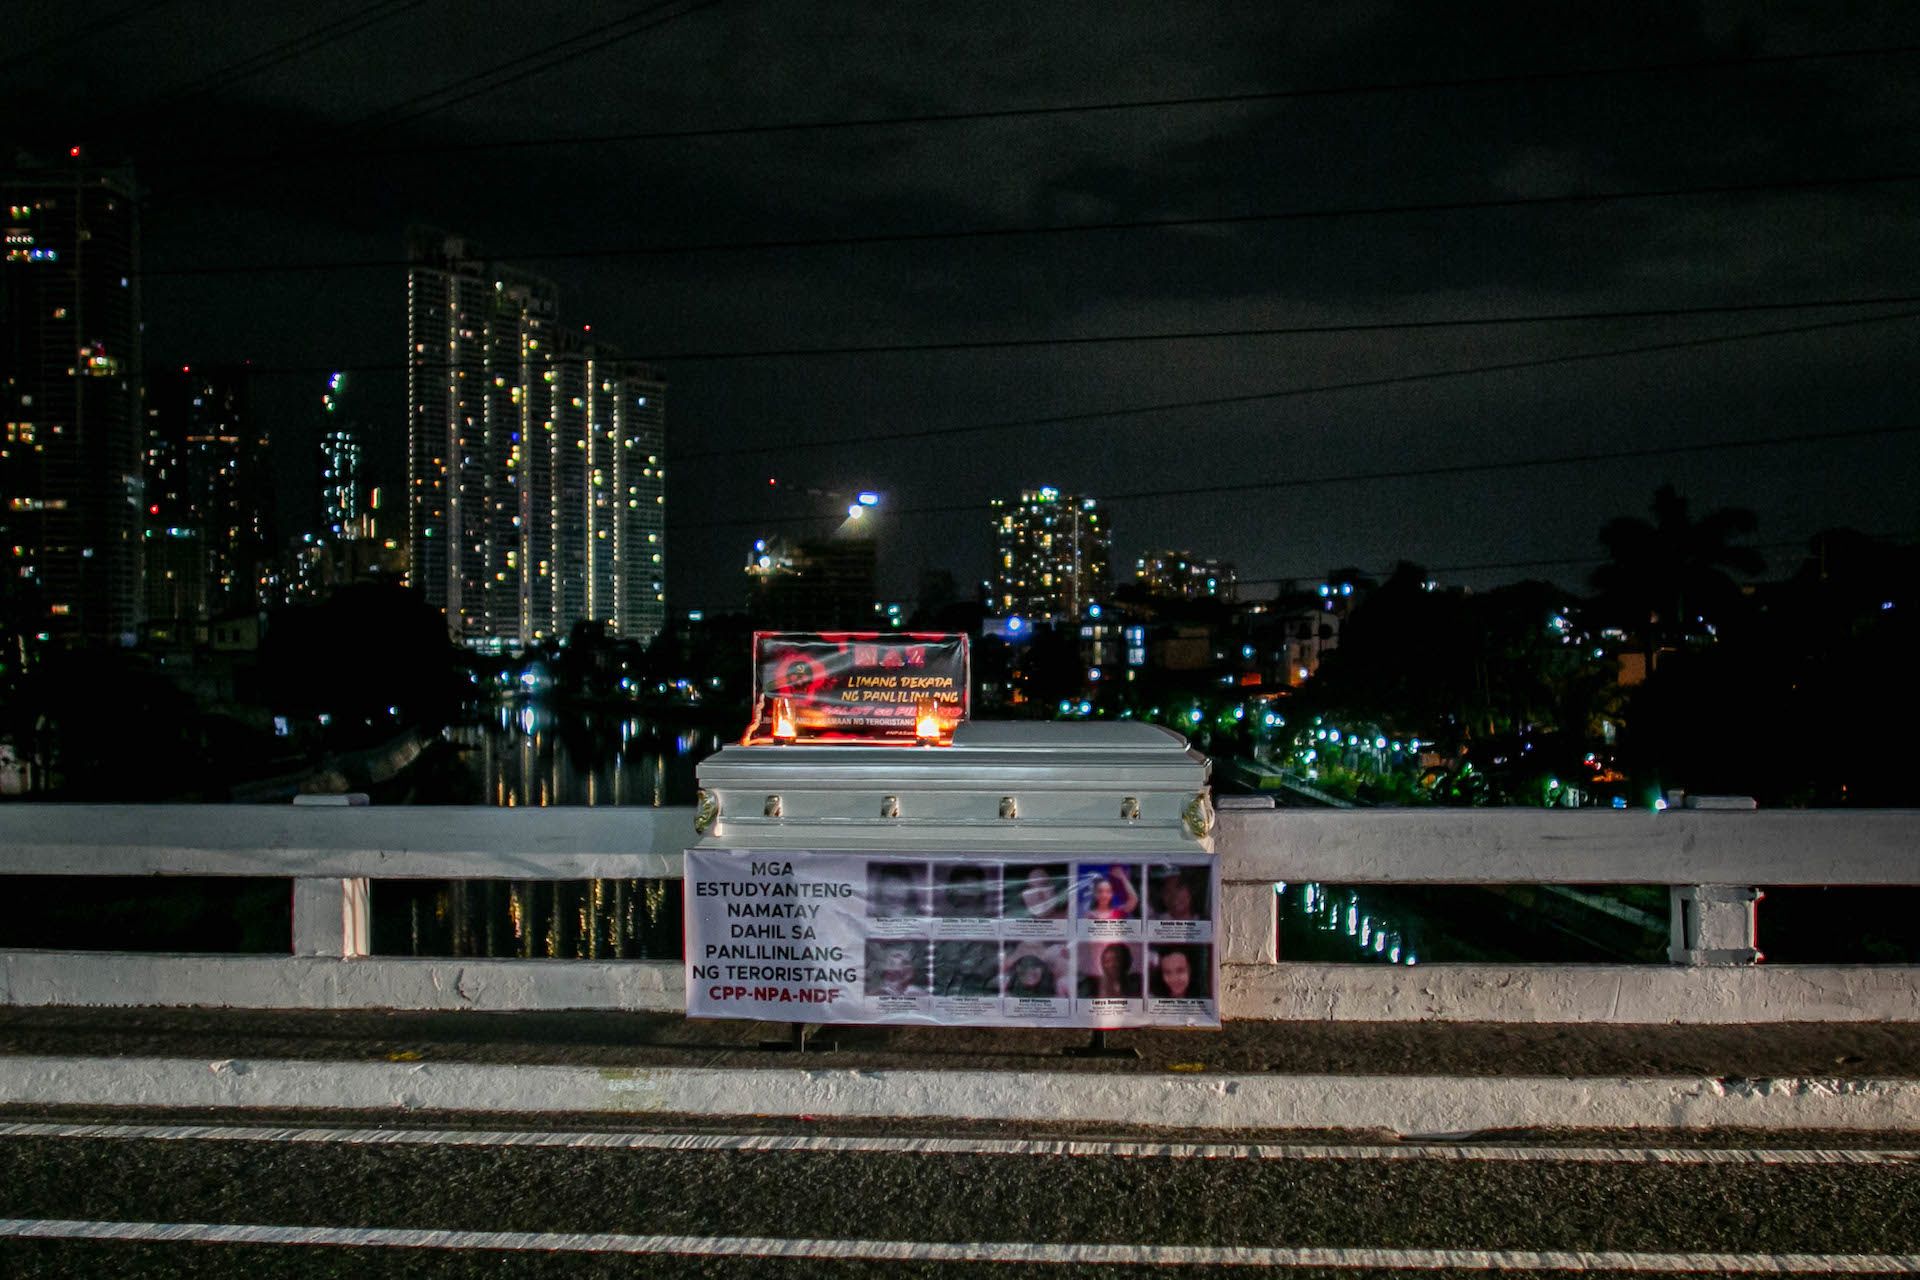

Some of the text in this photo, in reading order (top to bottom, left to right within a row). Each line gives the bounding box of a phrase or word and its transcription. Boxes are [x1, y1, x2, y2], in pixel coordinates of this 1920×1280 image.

[847, 676, 953, 689] LIMANG DEKADA
[841, 690, 860, 702] NG
[864, 717, 916, 726] TERORISTANG
[751, 862, 795, 876] MGA
[696, 882, 853, 898] ESTUDYANTENG
[727, 903, 821, 919] NAMATAY
[731, 924, 817, 940] DAHIL SA
[705, 944, 843, 962] PANLILINLANG
[692, 965, 857, 983] NG TERORISTANG
[709, 986, 841, 1004] CPP-NPA-NDF
